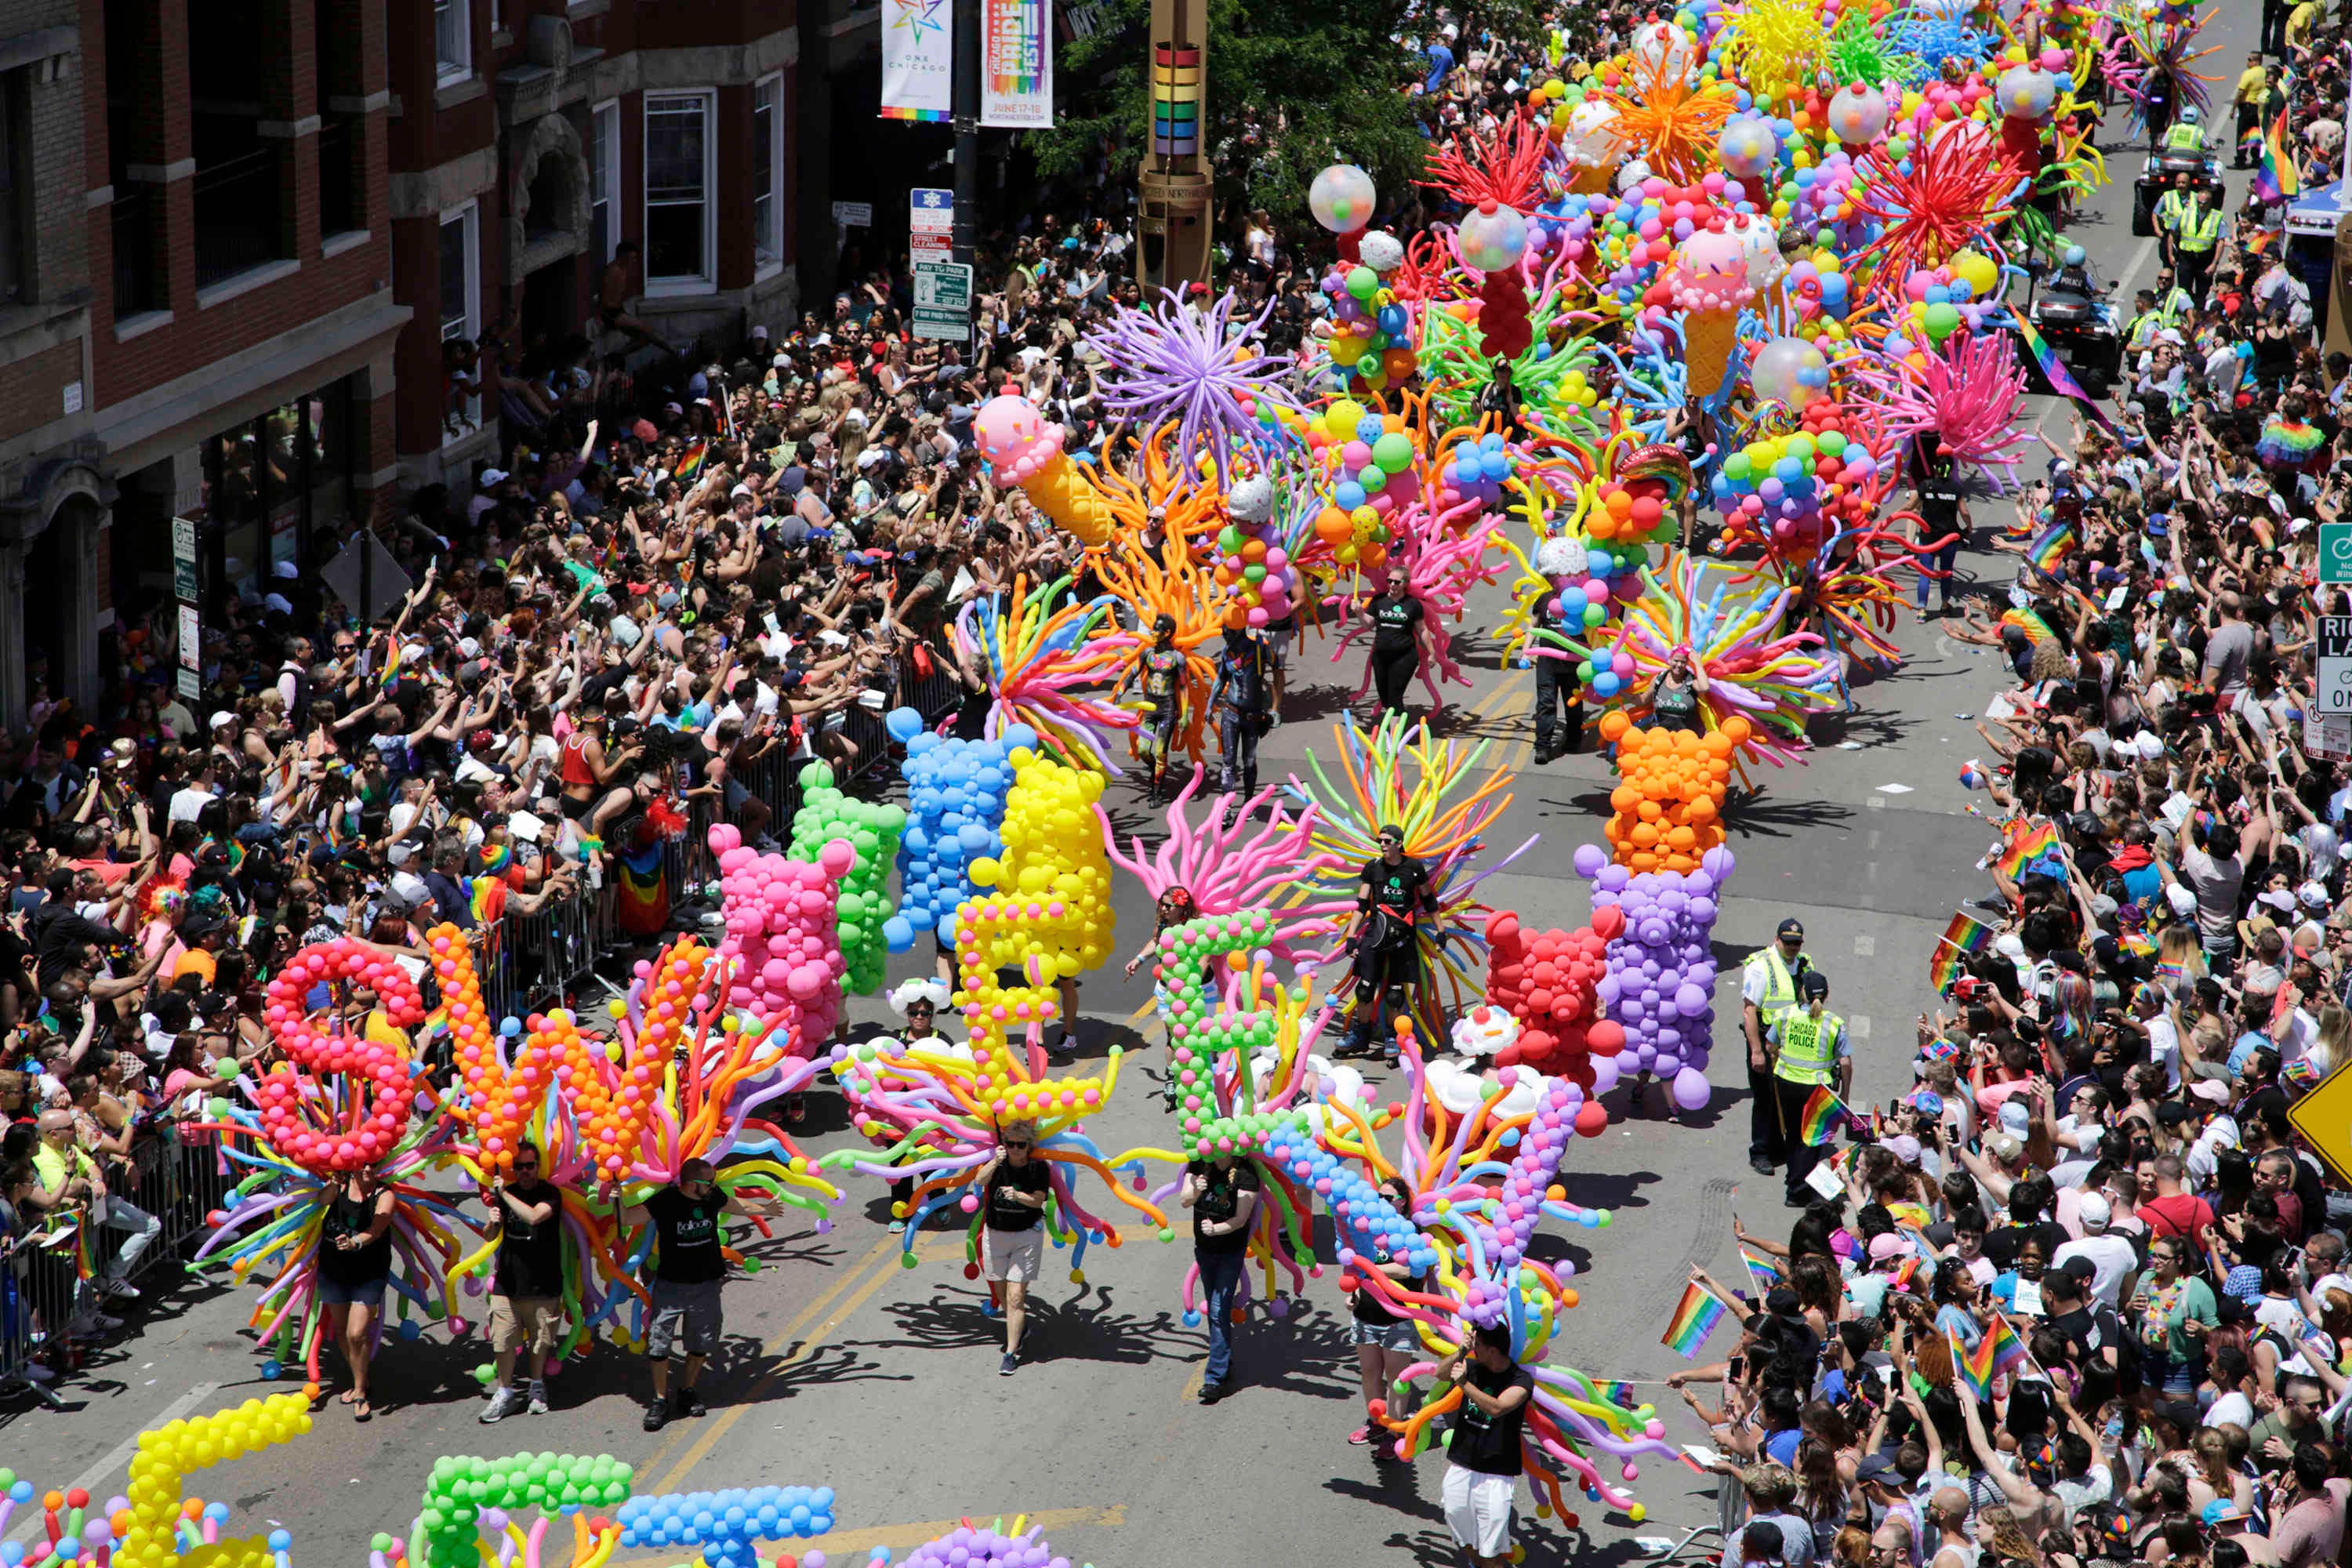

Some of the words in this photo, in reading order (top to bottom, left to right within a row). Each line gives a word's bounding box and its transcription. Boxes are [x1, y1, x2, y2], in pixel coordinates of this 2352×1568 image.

[1000, 2, 1023, 76] PRIDE
[990, 35, 1000, 75] CHICAGO
[1023, 38, 1039, 76] FEST
[888, 62, 946, 72] CHICAGO
[993, 103, 1017, 113] JUNE
[1018, 103, 1041, 113] 17-18
[946, 267, 965, 275] PARK
[2060, 276, 2083, 287] POLICE
[2308, 748, 2323, 758] TOW
[2326, 751, 2347, 762] ZONE
[1789, 1022, 1817, 1036] CHICAGO
[1788, 1033, 1816, 1048] POLICE
